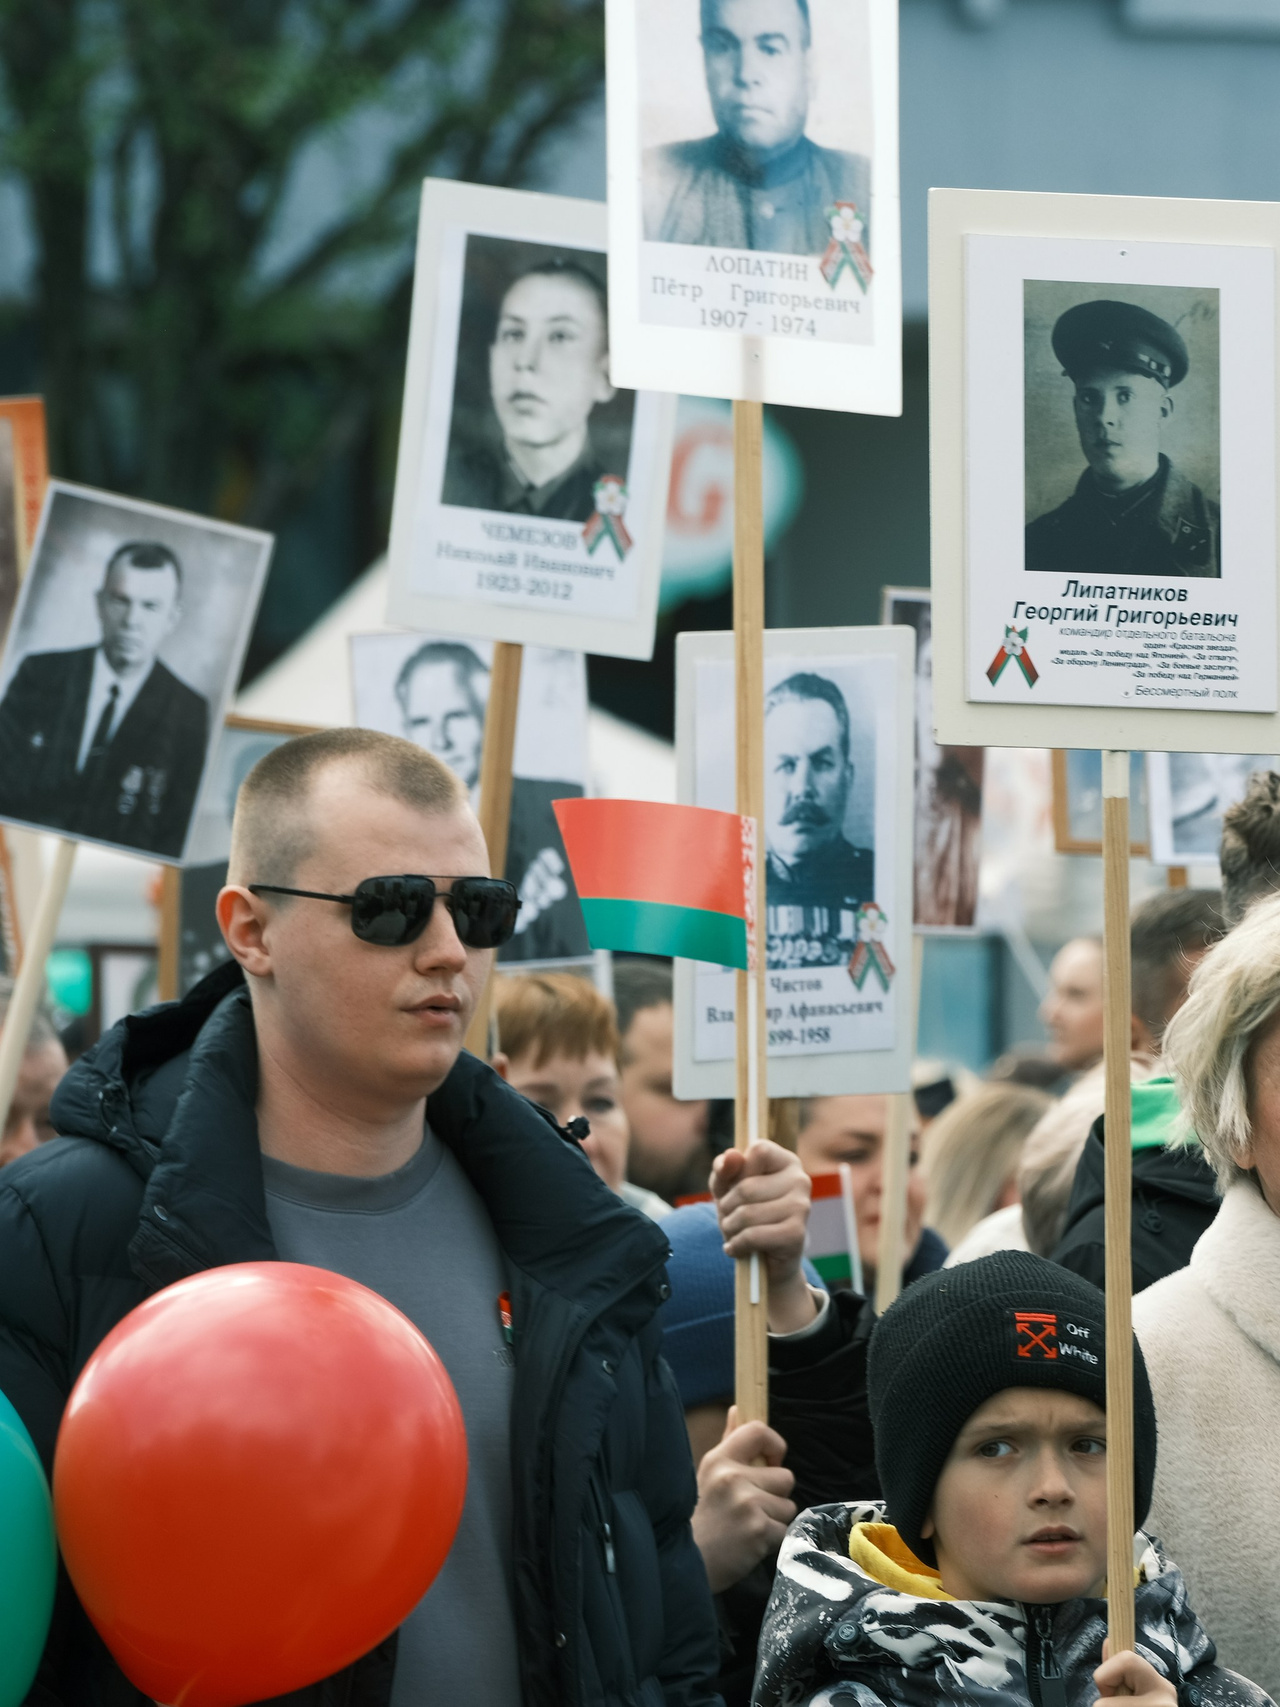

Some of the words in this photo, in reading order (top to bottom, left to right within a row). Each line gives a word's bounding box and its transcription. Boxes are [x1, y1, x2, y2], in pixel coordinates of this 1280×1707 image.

[705, 254, 808, 282] ЛОПАТИН
[652, 276, 704, 303] Пётр
[730, 283, 861, 314] Григорьевич
[700, 308, 748, 329] 1907
[770, 314, 816, 337] 1974
[1062, 580, 1188, 602] Липатников
[1013, 601, 1098, 625] Георгий
[1105, 605, 1238, 629] Григорьевич
[1059, 627, 1113, 639] командир
[1135, 685, 1210, 698] Бессмертный
[1212, 689, 1239, 698] полк
[770, 977, 822, 993] Чистов
[707, 1005, 782, 1023] Влаир
[767, 1027, 831, 1046] 899-1958
[1066, 1323, 1090, 1338] Off
[1058, 1341, 1099, 1364] White
